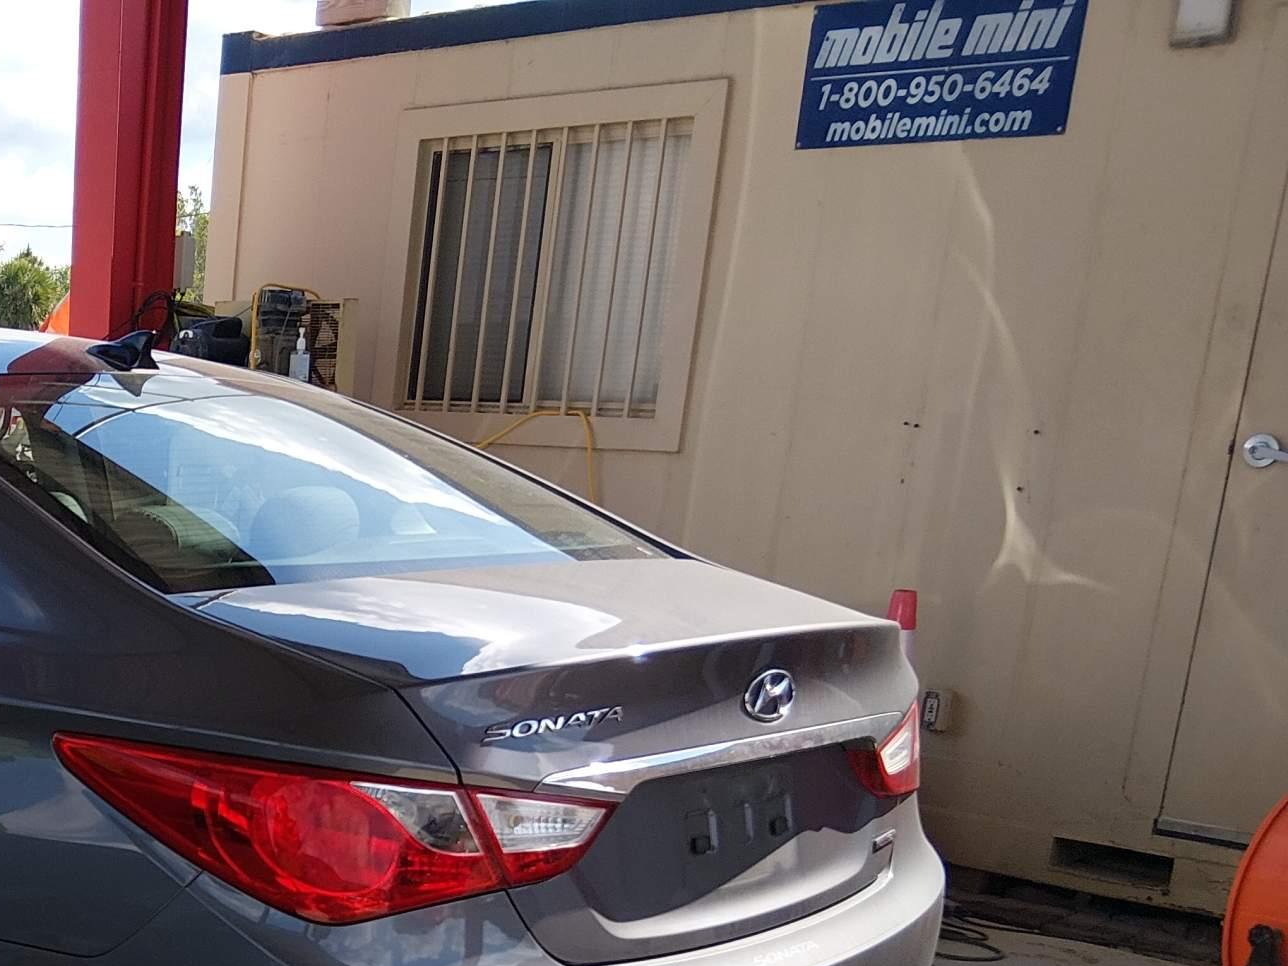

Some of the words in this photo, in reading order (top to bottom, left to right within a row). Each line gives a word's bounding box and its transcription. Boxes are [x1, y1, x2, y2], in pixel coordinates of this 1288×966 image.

[814, 0, 962, 69] mobile
[962, 0, 1076, 56] mini
[819, 66, 1052, 111] 1-800-950-6464
[825, 108, 1033, 143] mobilemini.com
[481, 705, 624, 746] SONATA
